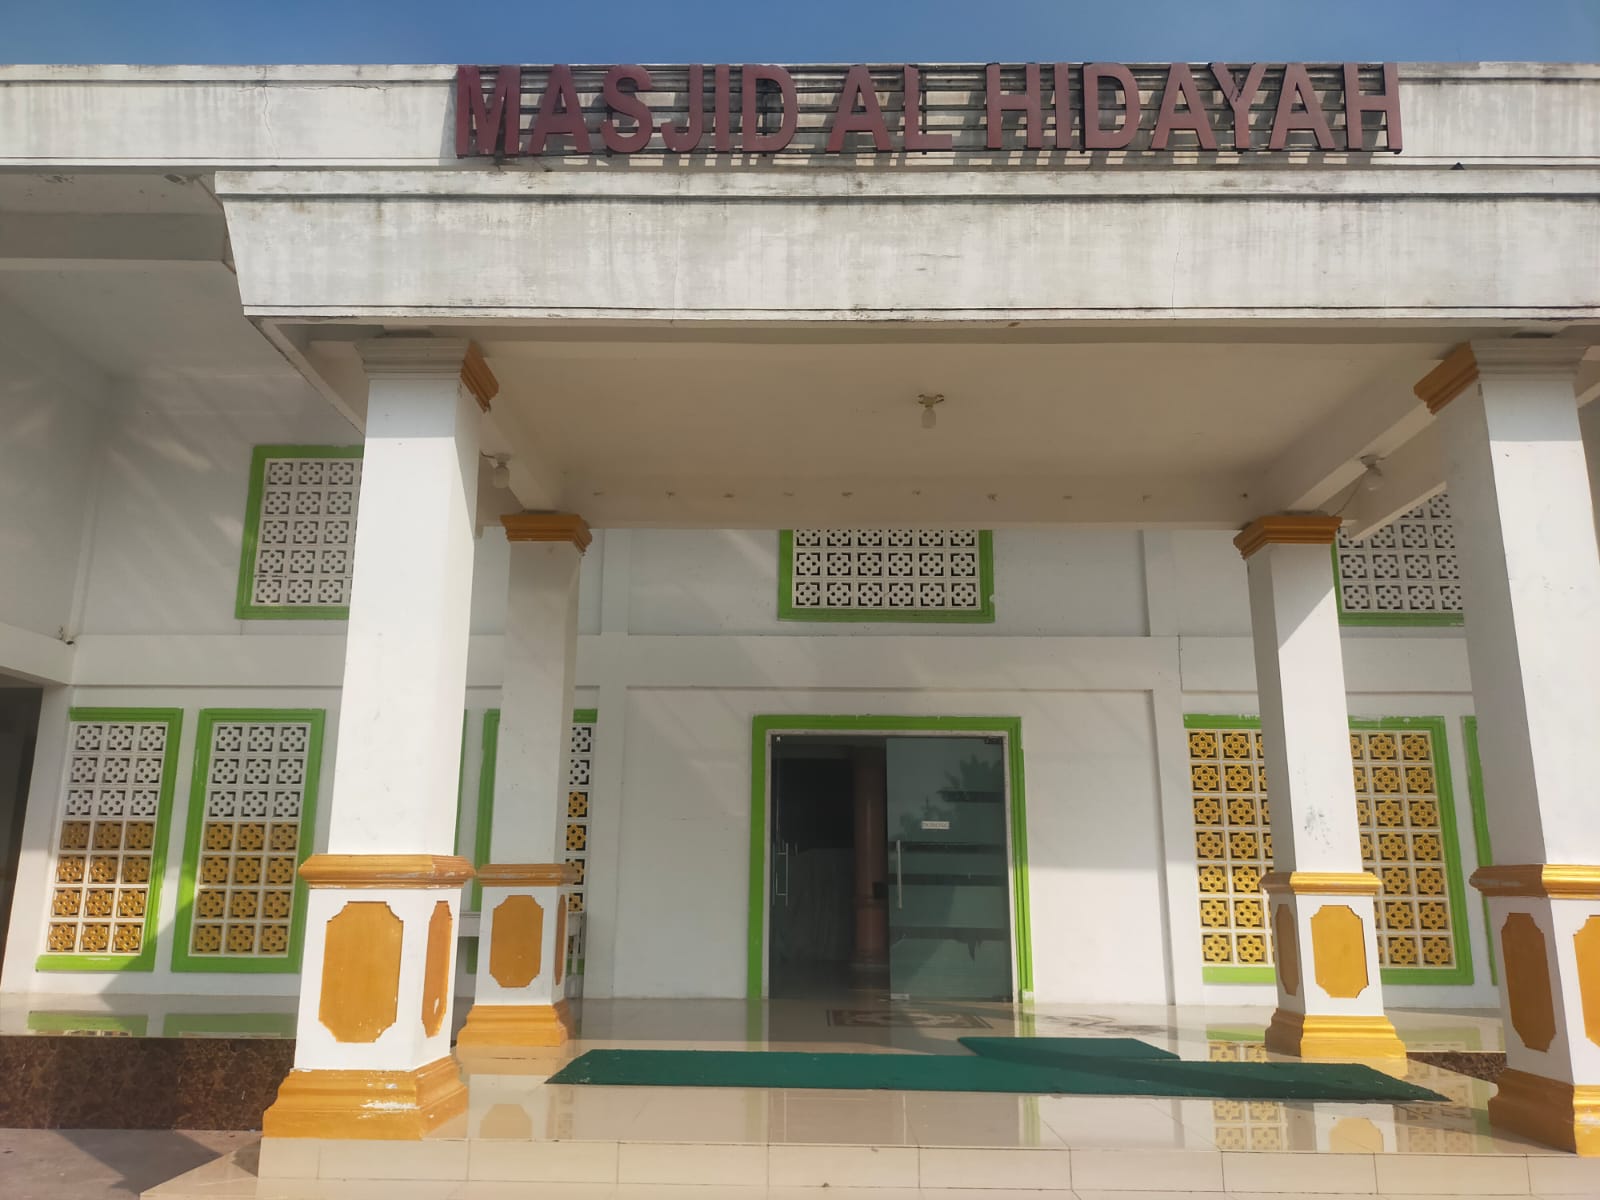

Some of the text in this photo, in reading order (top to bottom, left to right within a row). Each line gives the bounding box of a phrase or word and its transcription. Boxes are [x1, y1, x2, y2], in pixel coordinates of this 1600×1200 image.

[456, 62, 1403, 157] MASJID AL HIDAYAH
